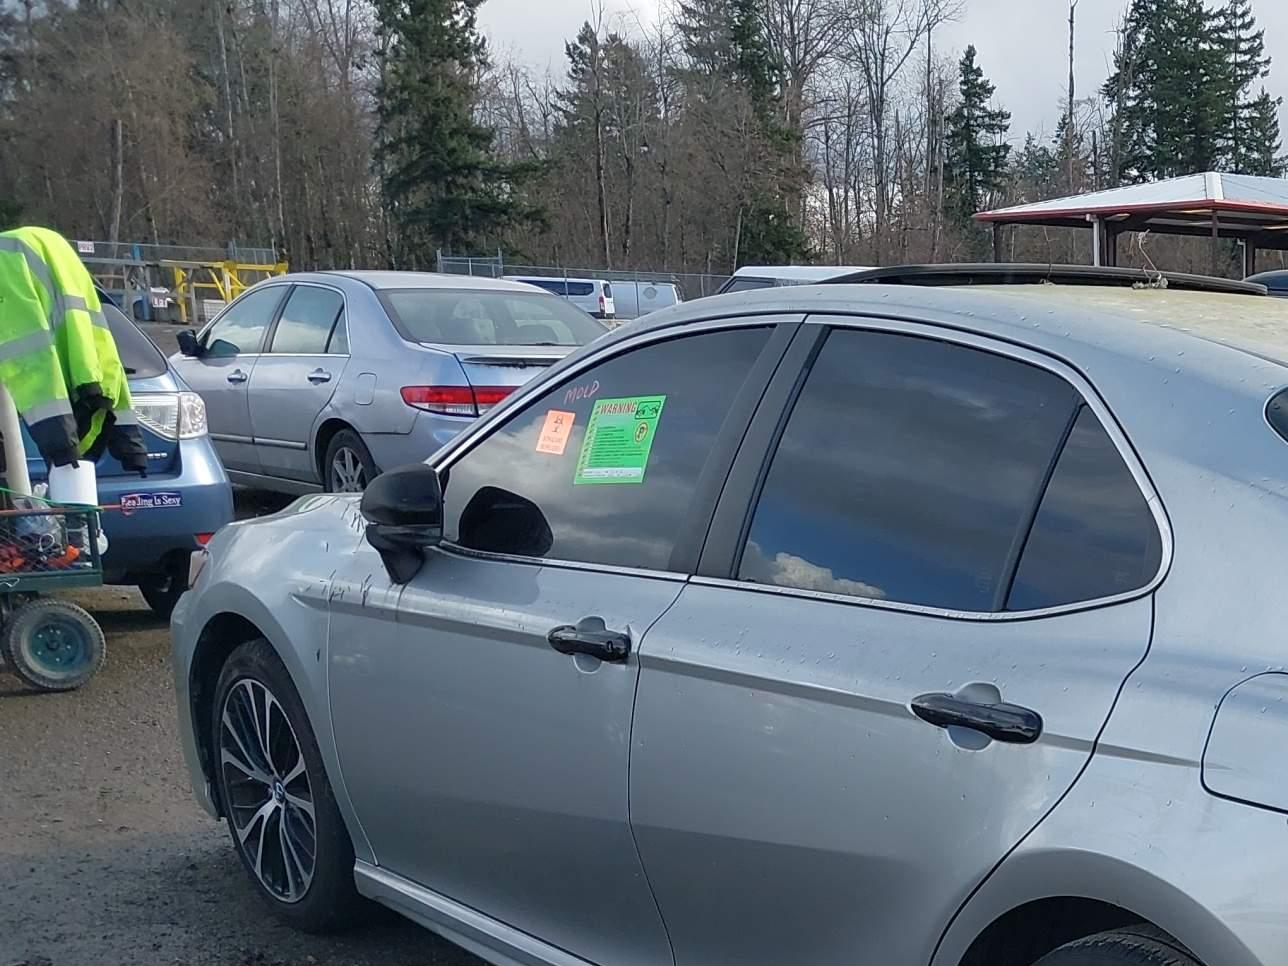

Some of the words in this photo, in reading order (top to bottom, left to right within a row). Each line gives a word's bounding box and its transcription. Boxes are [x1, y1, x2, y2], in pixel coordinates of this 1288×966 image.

[564, 380, 600, 405] MOLD
[599, 402, 638, 415] WARNING
[162, 495, 181, 506] Sexy
